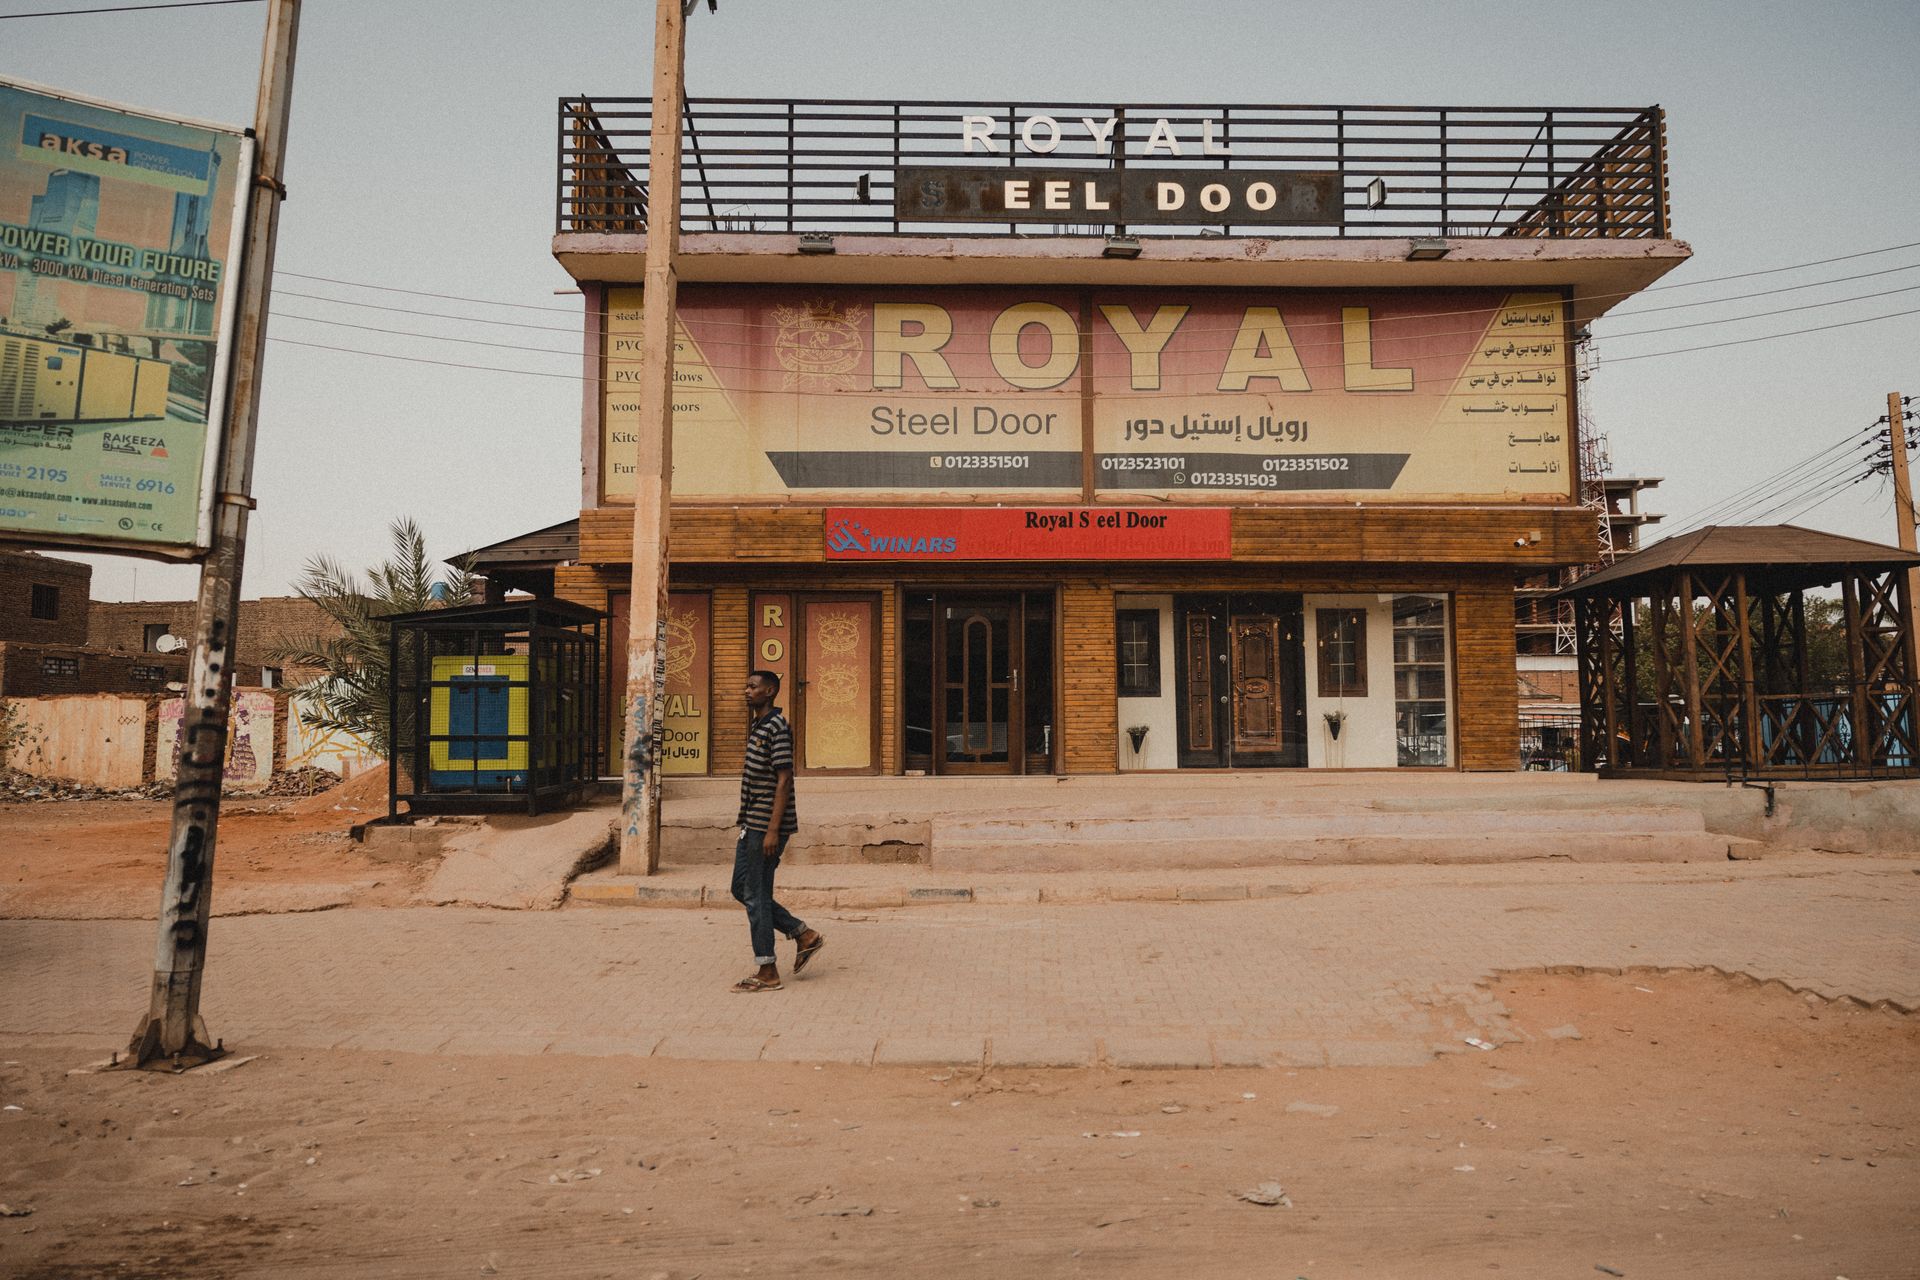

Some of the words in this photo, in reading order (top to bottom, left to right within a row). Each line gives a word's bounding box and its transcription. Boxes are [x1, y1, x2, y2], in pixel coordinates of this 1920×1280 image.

[962, 114, 1232, 157] ROYAL
[41, 133, 128, 165] aksa
[78, 239, 134, 267] YOUR
[142, 251, 220, 282] FUTURE
[33, 258, 63, 276] 3000
[67, 263, 88, 281] kVA
[92, 268, 126, 288] Diesel
[130, 275, 188, 299] Generating
[191, 285, 215, 301] Sets
[872, 301, 1415, 393] ROYAL
[870, 406, 958, 436] Steel
[973, 406, 1058, 436] Door
[1124, 418, 1164, 441] دور
[1170, 412, 1242, 442] إستيل
[1246, 415, 1308, 443] رويال
[103, 432, 166, 448] RAKEEZA
[944, 455, 1030, 469] 0123351501
[1101, 456, 1186, 470] 0123523101
[1262, 458, 1349, 472] 0123351502
[26, 466, 68, 482] 2195
[1190, 472, 1278, 487] 0123351503
[136, 479, 175, 495] 6916
[1025, 511, 1073, 532] Royal
[1126, 511, 1168, 529] Door
[869, 537, 957, 553] WINARS
[673, 746, 700, 759] رويال
